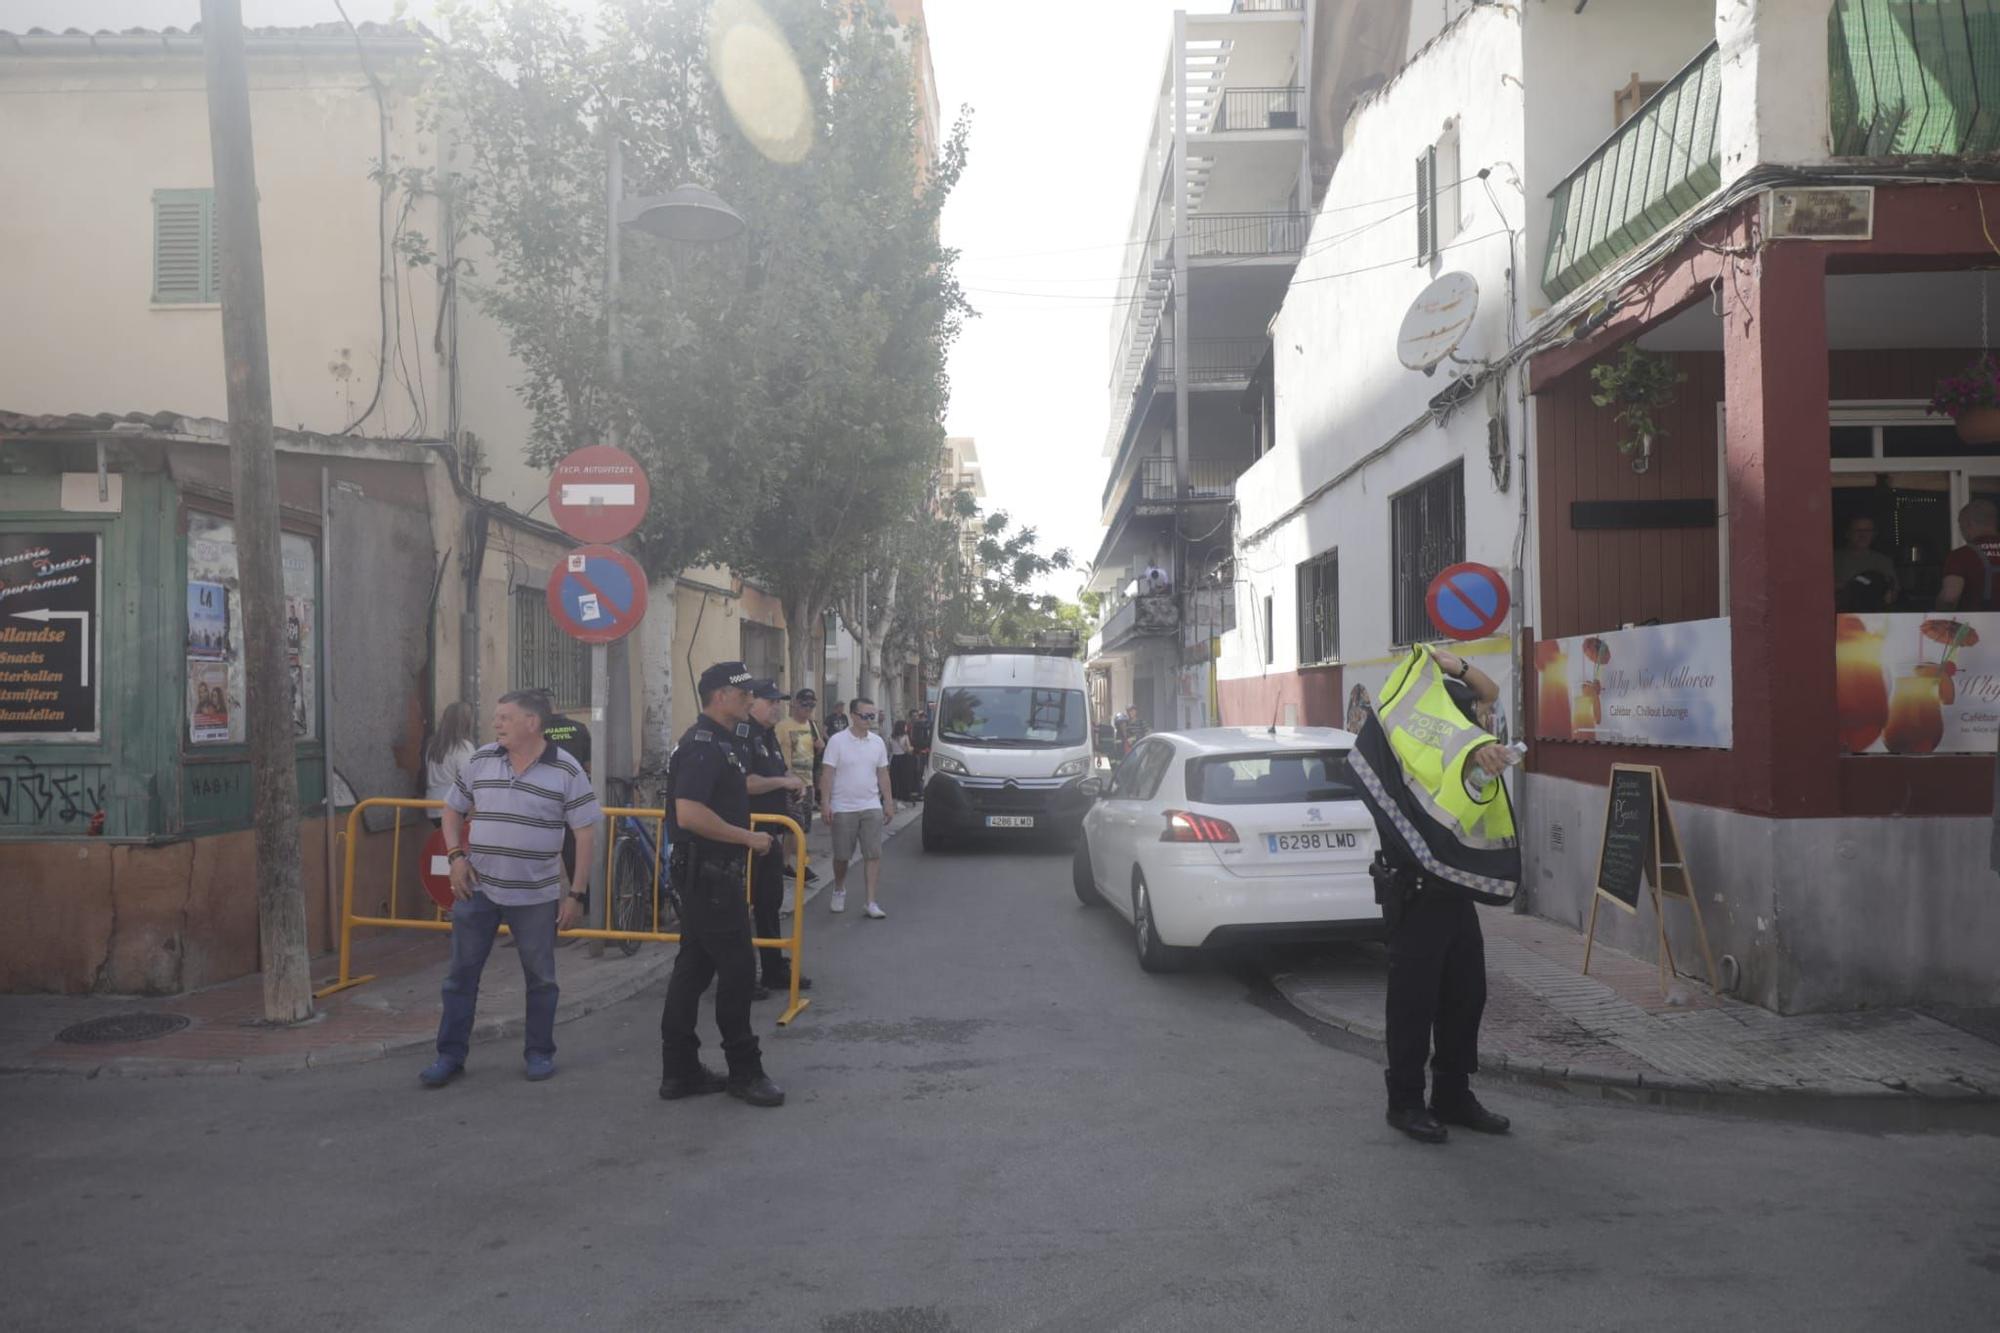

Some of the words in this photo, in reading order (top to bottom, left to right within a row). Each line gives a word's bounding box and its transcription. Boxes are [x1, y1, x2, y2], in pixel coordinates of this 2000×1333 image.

[1609, 669, 1630, 697] Why
[1657, 665, 1714, 689] Mallorca
[1662, 705, 1689, 721] Lounge
[551, 733, 573, 741] CIVIL
[1279, 833, 1321, 850] 6298
[1326, 832, 1356, 849] LMD
